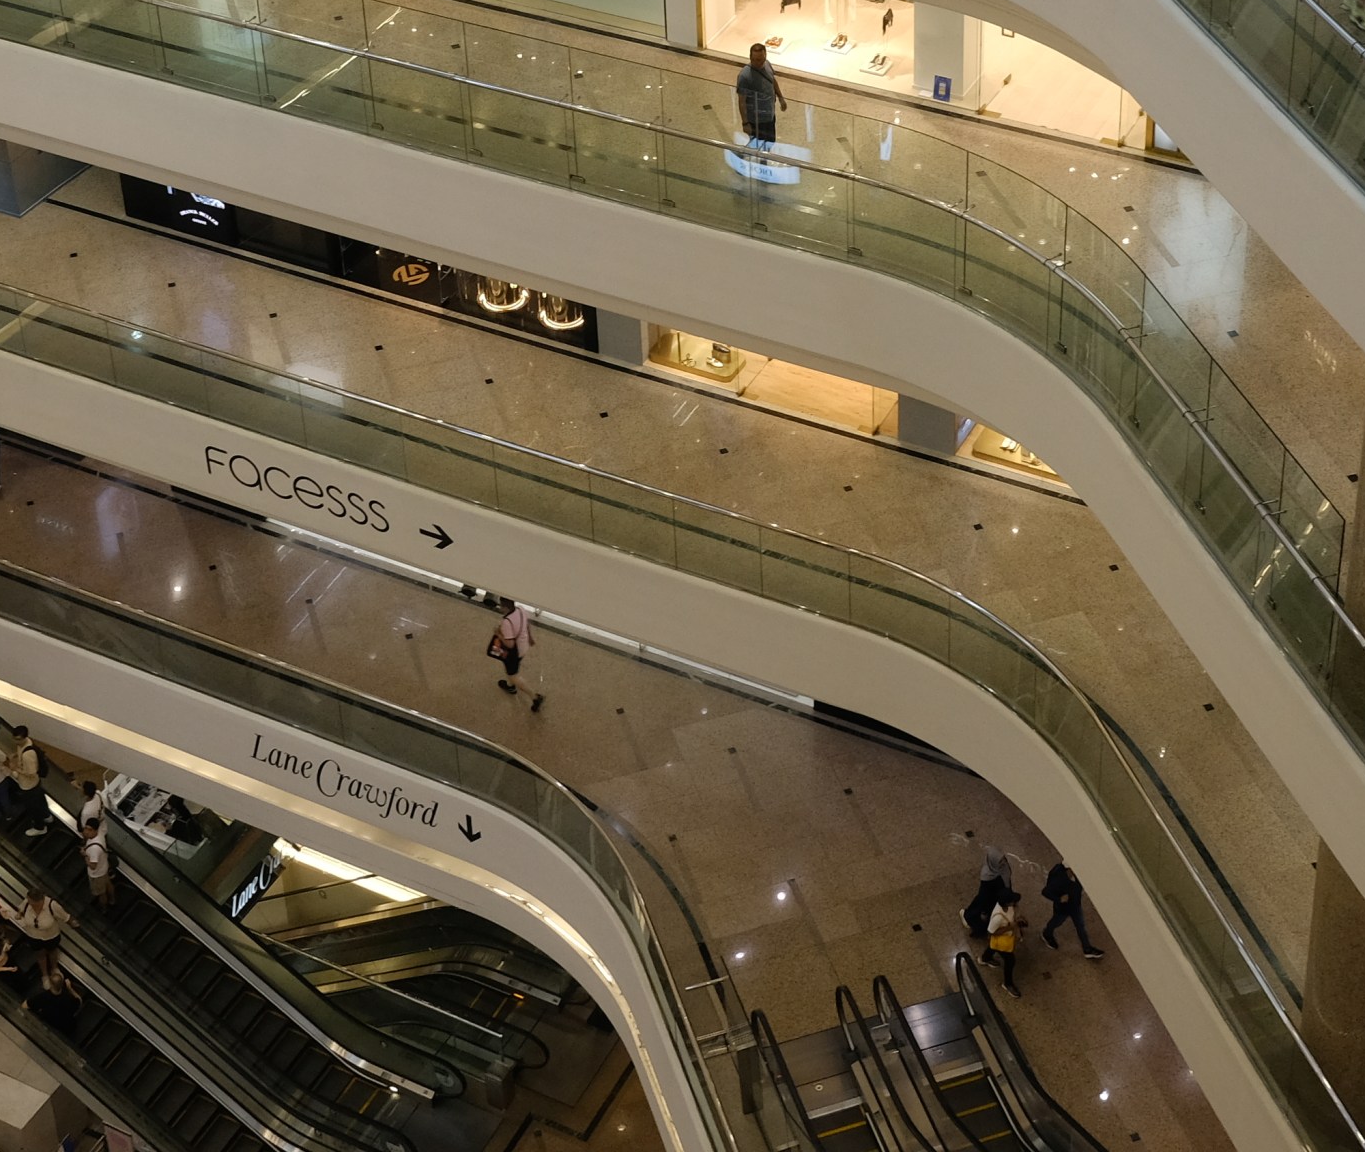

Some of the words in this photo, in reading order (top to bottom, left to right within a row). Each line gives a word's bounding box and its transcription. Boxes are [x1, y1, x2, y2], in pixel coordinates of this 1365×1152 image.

[250, 732, 313, 779] Lane
[316, 758, 439, 828] Crawford
[231, 876, 259, 918] Lane
